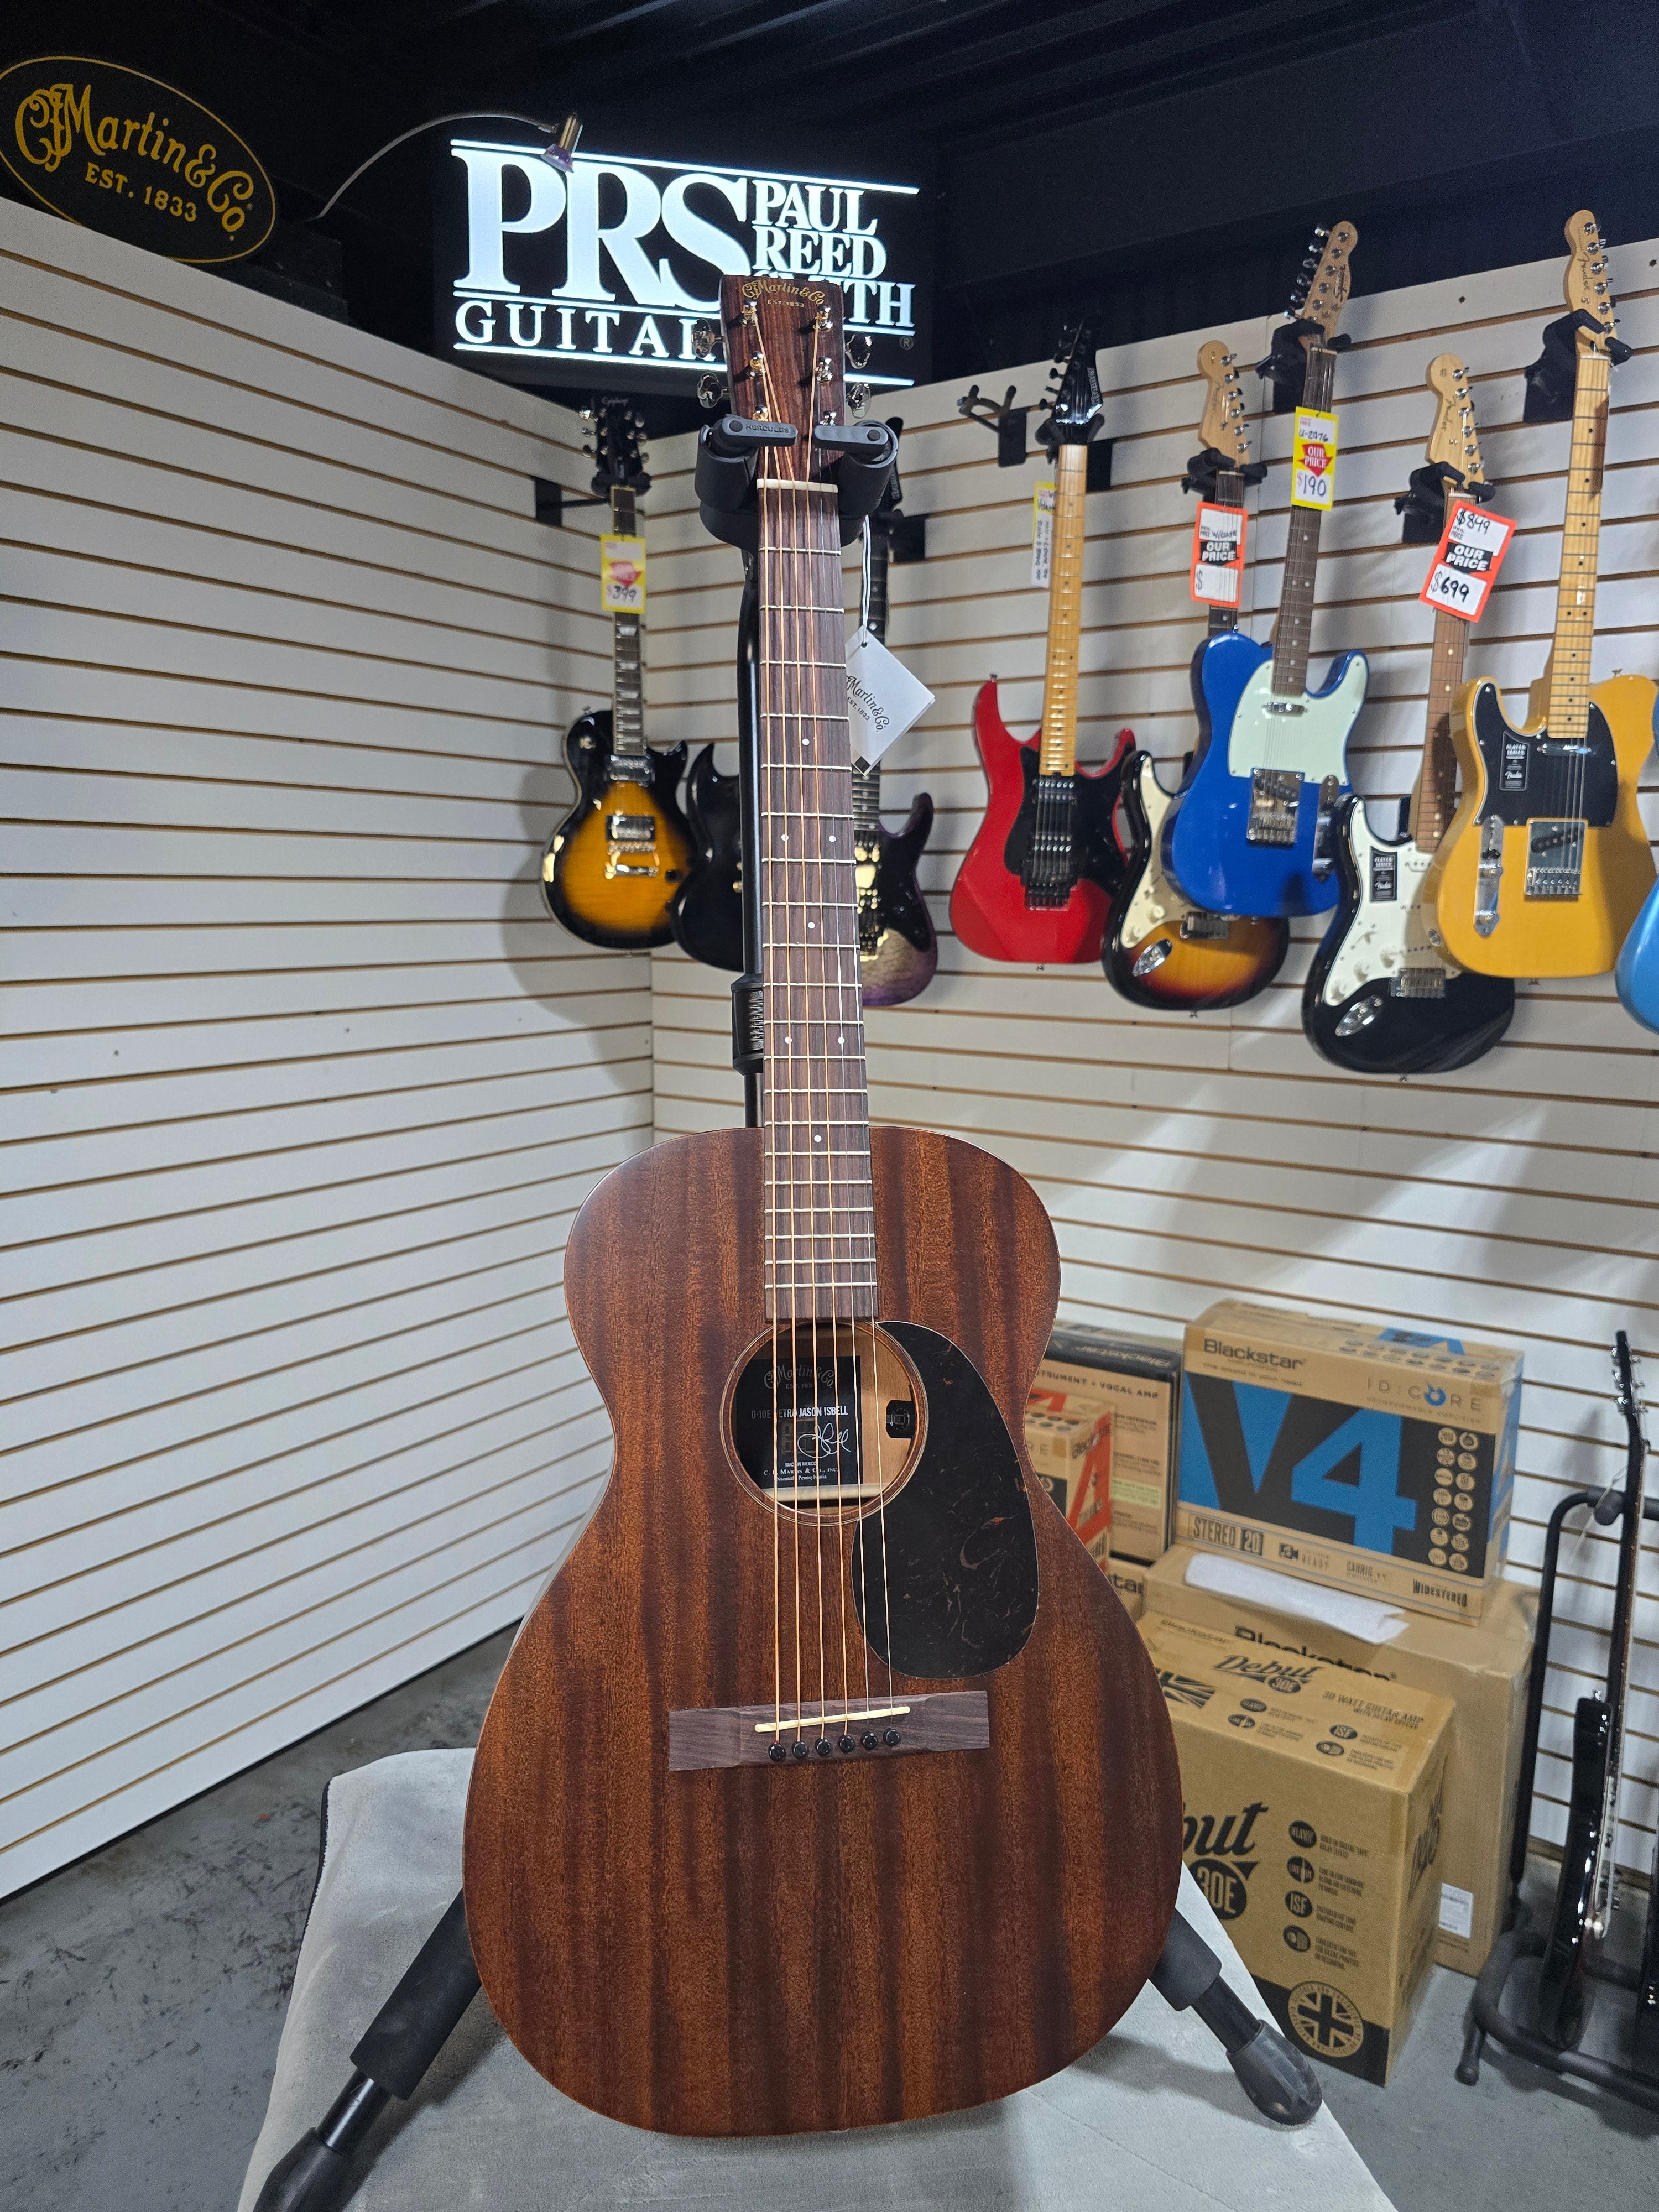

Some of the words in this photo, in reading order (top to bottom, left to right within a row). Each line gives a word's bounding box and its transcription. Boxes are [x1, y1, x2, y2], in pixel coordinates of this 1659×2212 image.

[85, 163, 133, 197] EST.
[144, 186, 197, 222] 1833
[752, 179, 879, 236] PAUL
[451, 147, 752, 314] PRS
[752, 224, 886, 280] REED
[745, 424, 789, 434] HERCULES
[1305, 456, 1327, 469] PRICE
[1308, 446, 1324, 457] OUR
[1457, 509, 1491, 535] $849
[1202, 550, 1236, 561] PRICE
[1206, 541, 1229, 551] OUR
[1454, 543, 1485, 560] OUR
[1446, 552, 1489, 571] PRICE
[1431, 571, 1469, 603] $699
[857, 707, 870, 721] 1833
[1203, 1337, 1305, 1370] Blackstar
[1099, 1381, 1133, 1395] VOCAL
[1136, 1389, 1159, 1399] AMP
[799, 1407, 822, 1417] JASON
[824, 1405, 849, 1416] ISBELL
[1193, 1516, 1237, 1548] STEREO
[1244, 1530, 1262, 1555] 20
[1301, 1553, 1329, 1571] READY
[1412, 1578, 1468, 1608] WIDESTEREO
[1212, 1654, 1324, 1680] Debut
[1338, 1694, 1364, 1708] WATT
[1365, 1702, 1401, 1718] GUITAR
[1401, 1712, 1425, 1723] AMP
[1196, 1865, 1238, 1916] 30E
